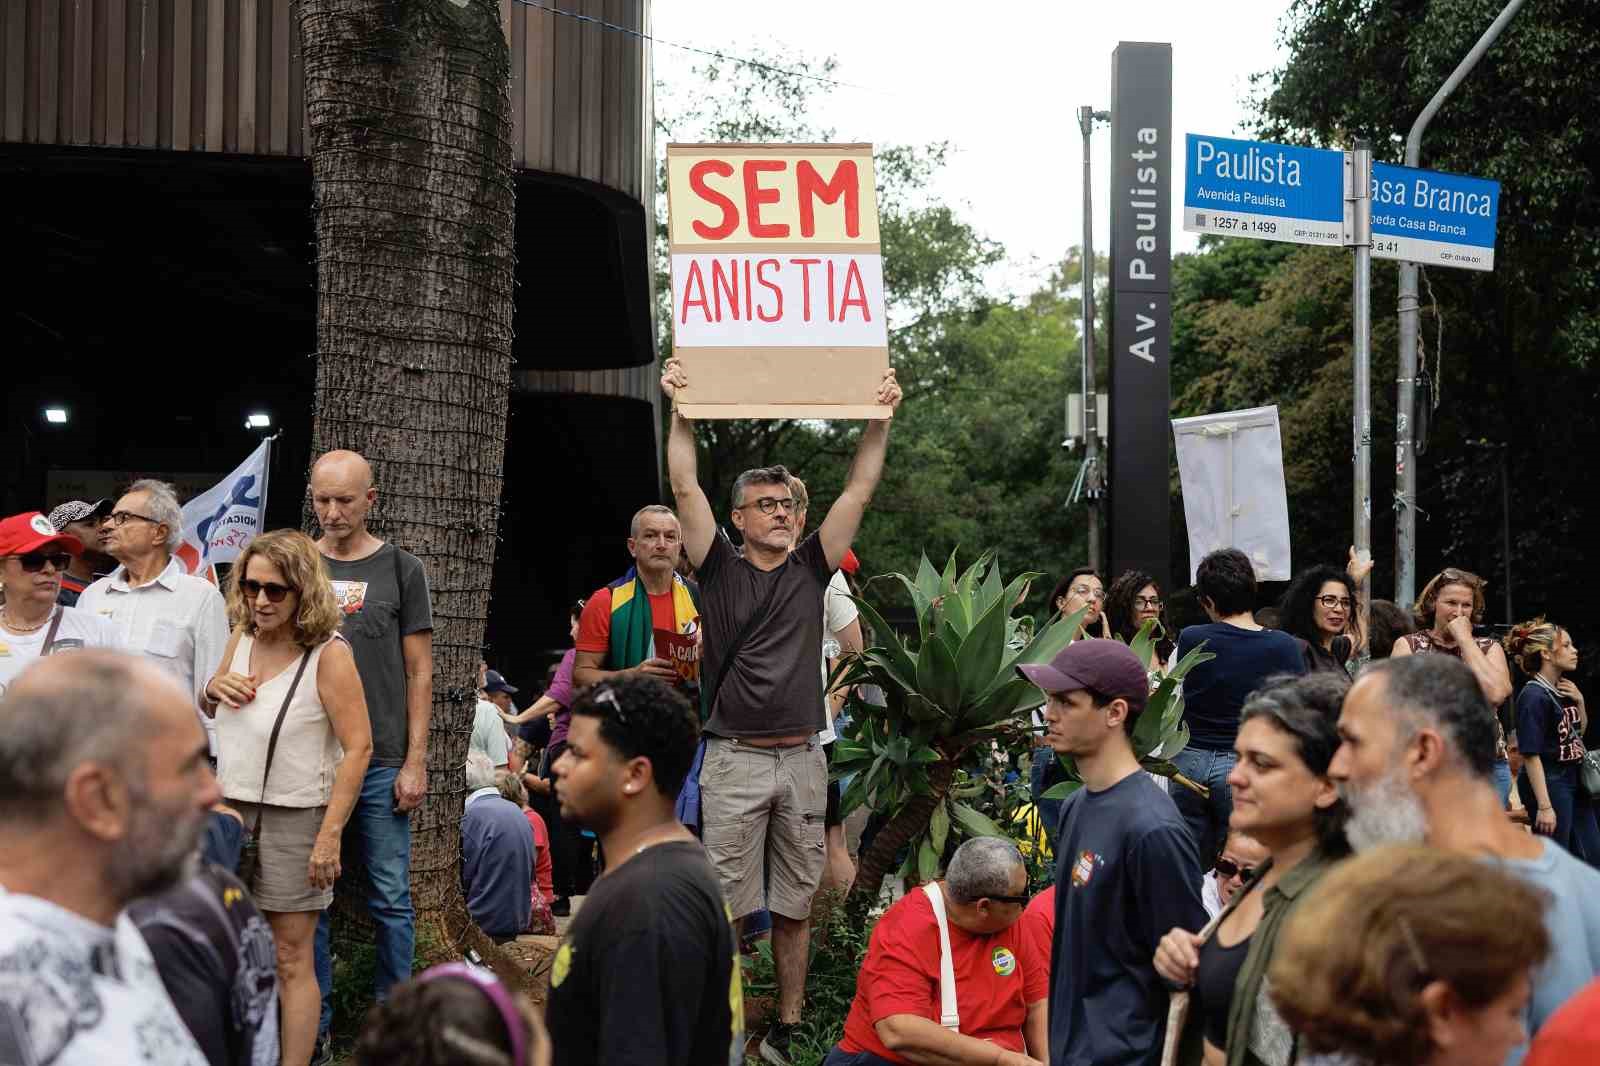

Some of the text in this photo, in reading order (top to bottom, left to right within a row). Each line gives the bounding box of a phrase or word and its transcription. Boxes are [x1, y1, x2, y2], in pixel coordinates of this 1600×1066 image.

[1196, 140, 1302, 187] Paulista
[688, 159, 860, 241] SEM
[1197, 186, 1286, 208] Avenida Paulista
[1371, 179, 1491, 217] asa Branca
[1212, 216, 1277, 234] 1257 a 1499
[1398, 216, 1426, 231] Casa
[1428, 220, 1467, 236] Branca
[1128, 127, 1158, 364] Av. Paulista
[1386, 241, 1399, 253] 41
[681, 258, 872, 325] ANISTIA
